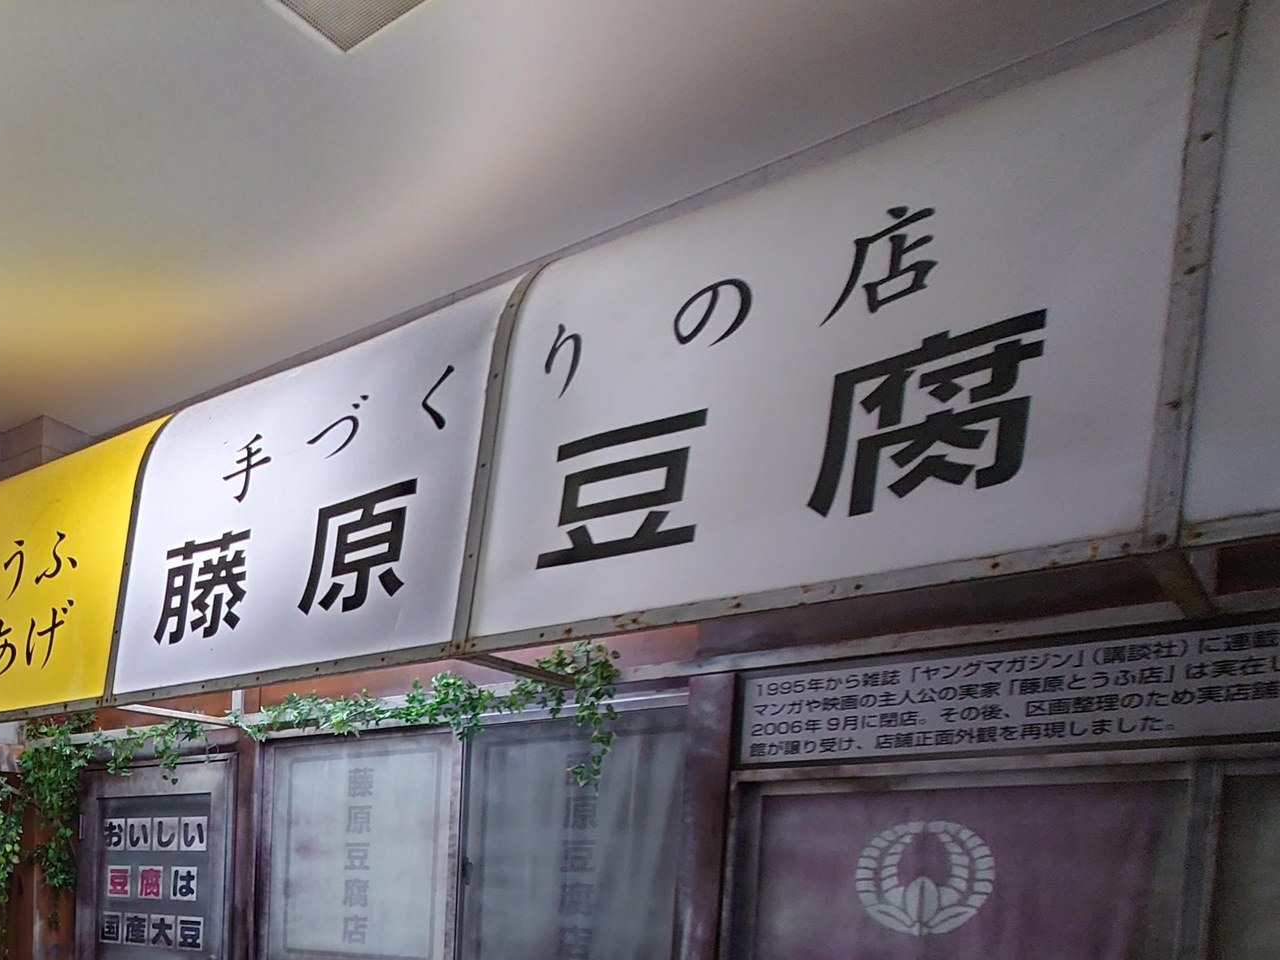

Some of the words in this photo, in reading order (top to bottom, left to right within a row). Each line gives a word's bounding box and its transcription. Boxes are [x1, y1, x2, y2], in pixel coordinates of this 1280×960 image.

[104, 821, 205, 848] おいしい
[341, 767, 375, 946] 藤原豆腐店
[109, 868, 196, 897] 豆腐は
[101, 914, 202, 949] 国産大豆
